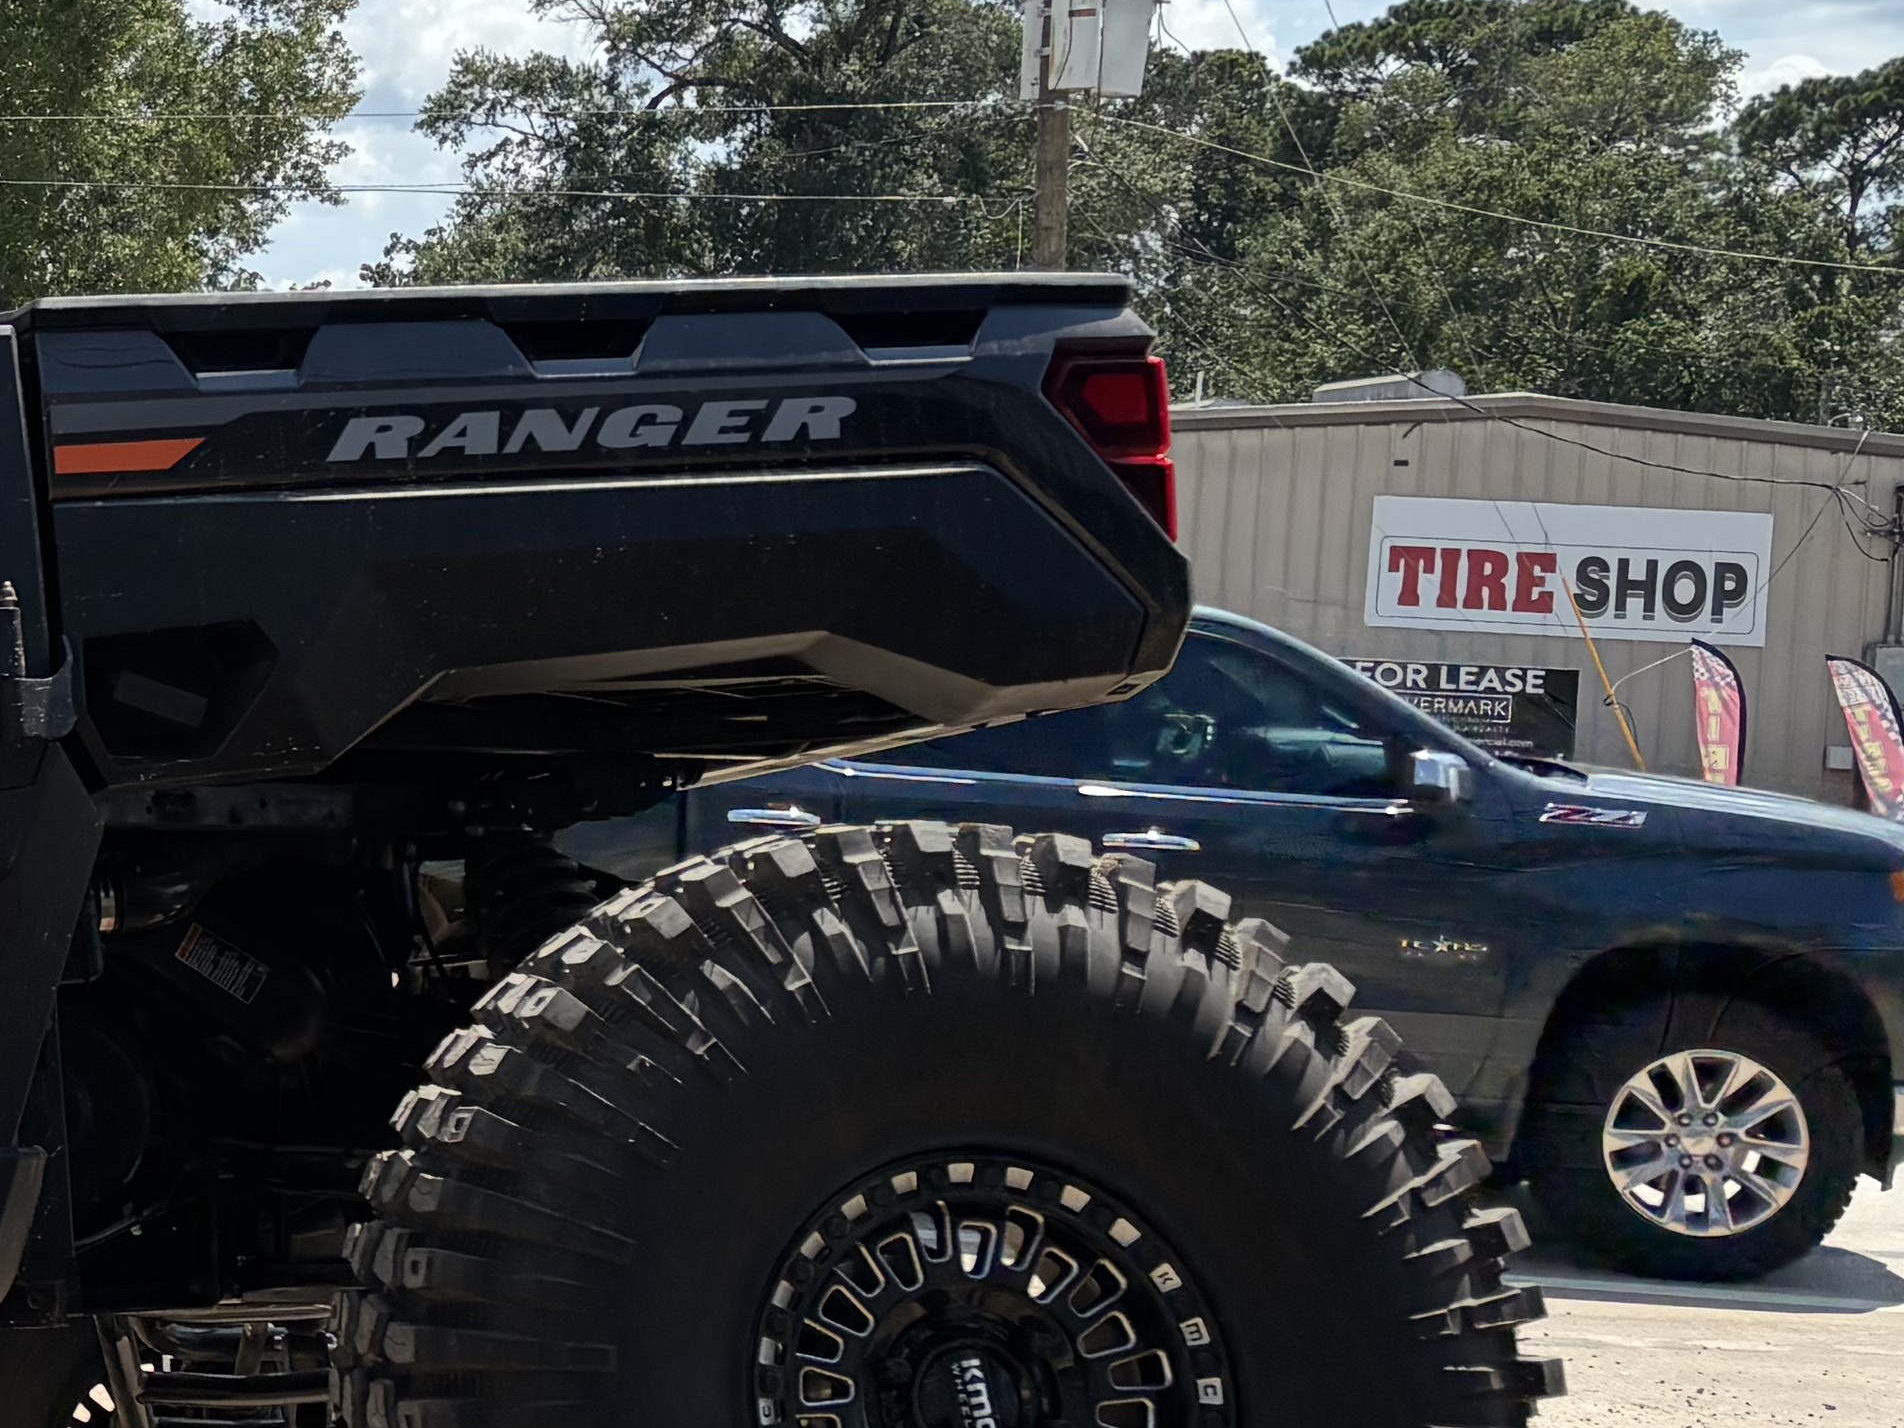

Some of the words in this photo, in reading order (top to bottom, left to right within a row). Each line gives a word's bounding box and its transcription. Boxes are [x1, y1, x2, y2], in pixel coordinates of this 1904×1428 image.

[326, 396, 857, 462] RANGER
[1388, 545, 1558, 614] TIRE
[1573, 556, 1748, 624] SHOP
[1440, 666, 1546, 694] LEASE
